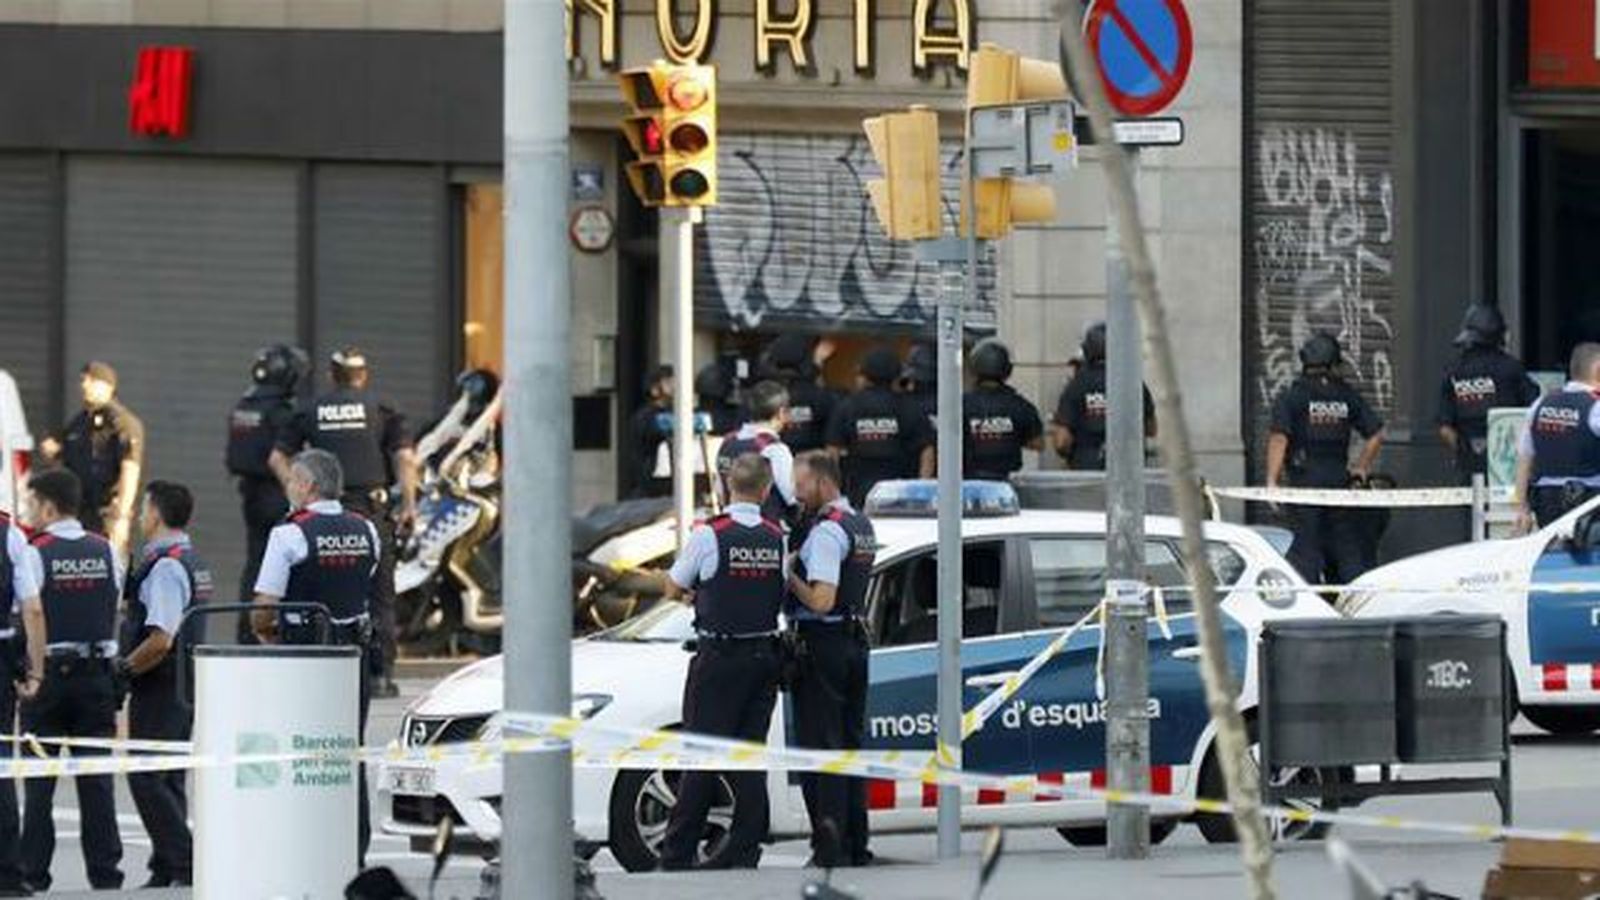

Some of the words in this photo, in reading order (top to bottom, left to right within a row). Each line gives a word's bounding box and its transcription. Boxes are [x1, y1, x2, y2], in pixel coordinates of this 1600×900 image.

[317, 403, 366, 420] POLICIA
[316, 535, 370, 548] POLICIA
[729, 546, 780, 561] POLICIA
[51, 558, 108, 573] POLICIA
